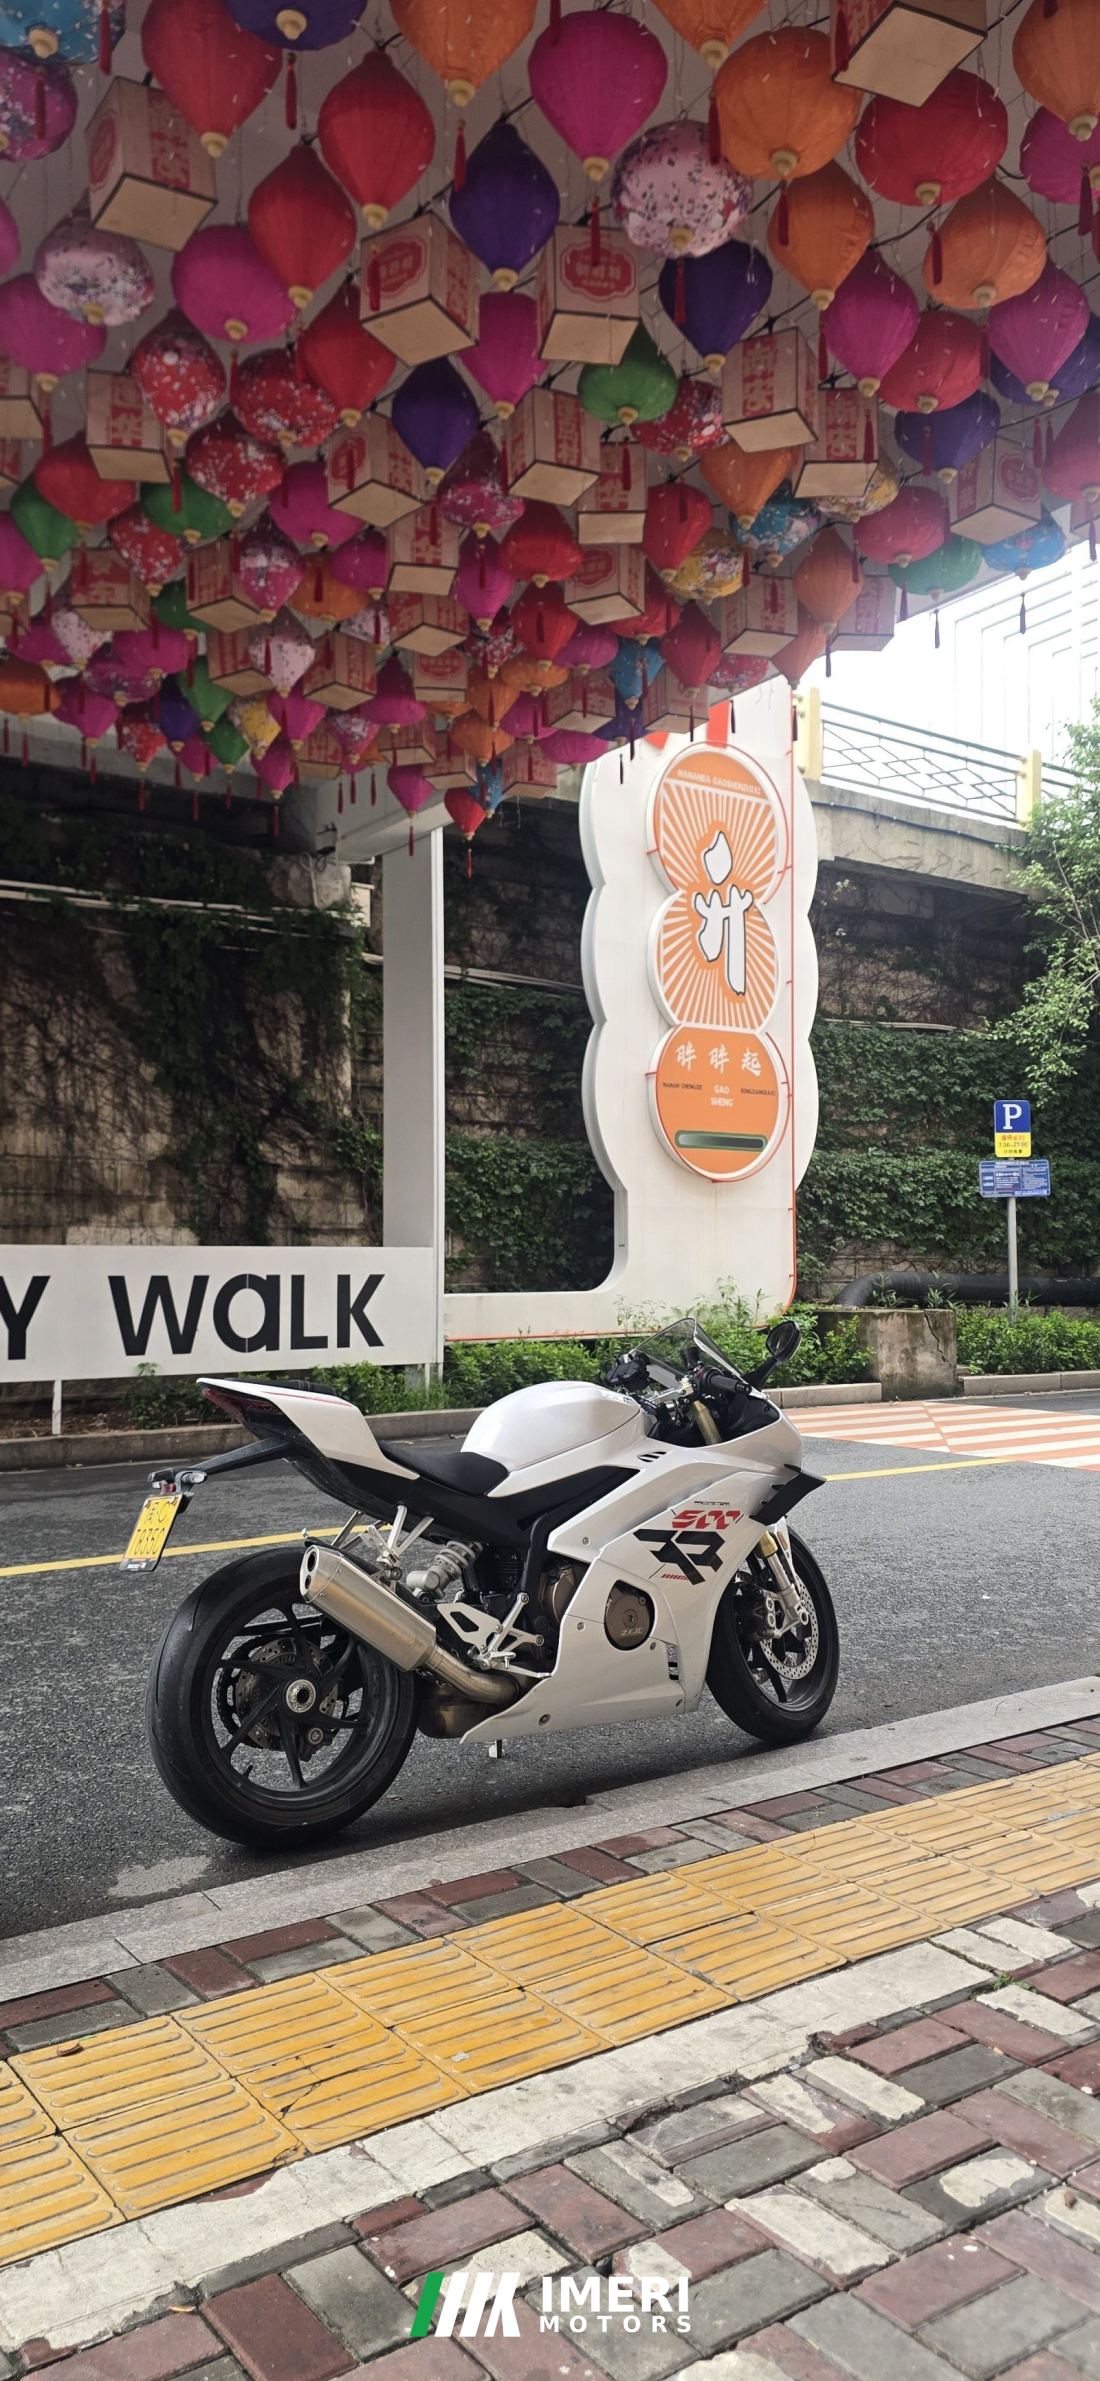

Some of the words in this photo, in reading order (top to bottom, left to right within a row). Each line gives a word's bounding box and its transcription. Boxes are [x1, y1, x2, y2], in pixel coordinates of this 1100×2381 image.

[714, 1085, 730, 1094] GAO
[710, 1097, 734, 1107] SHENG
[1002, 1103, 1022, 1130] P
[0, 1275, 51, 1361] Y
[672, 1509, 741, 1530] 500
